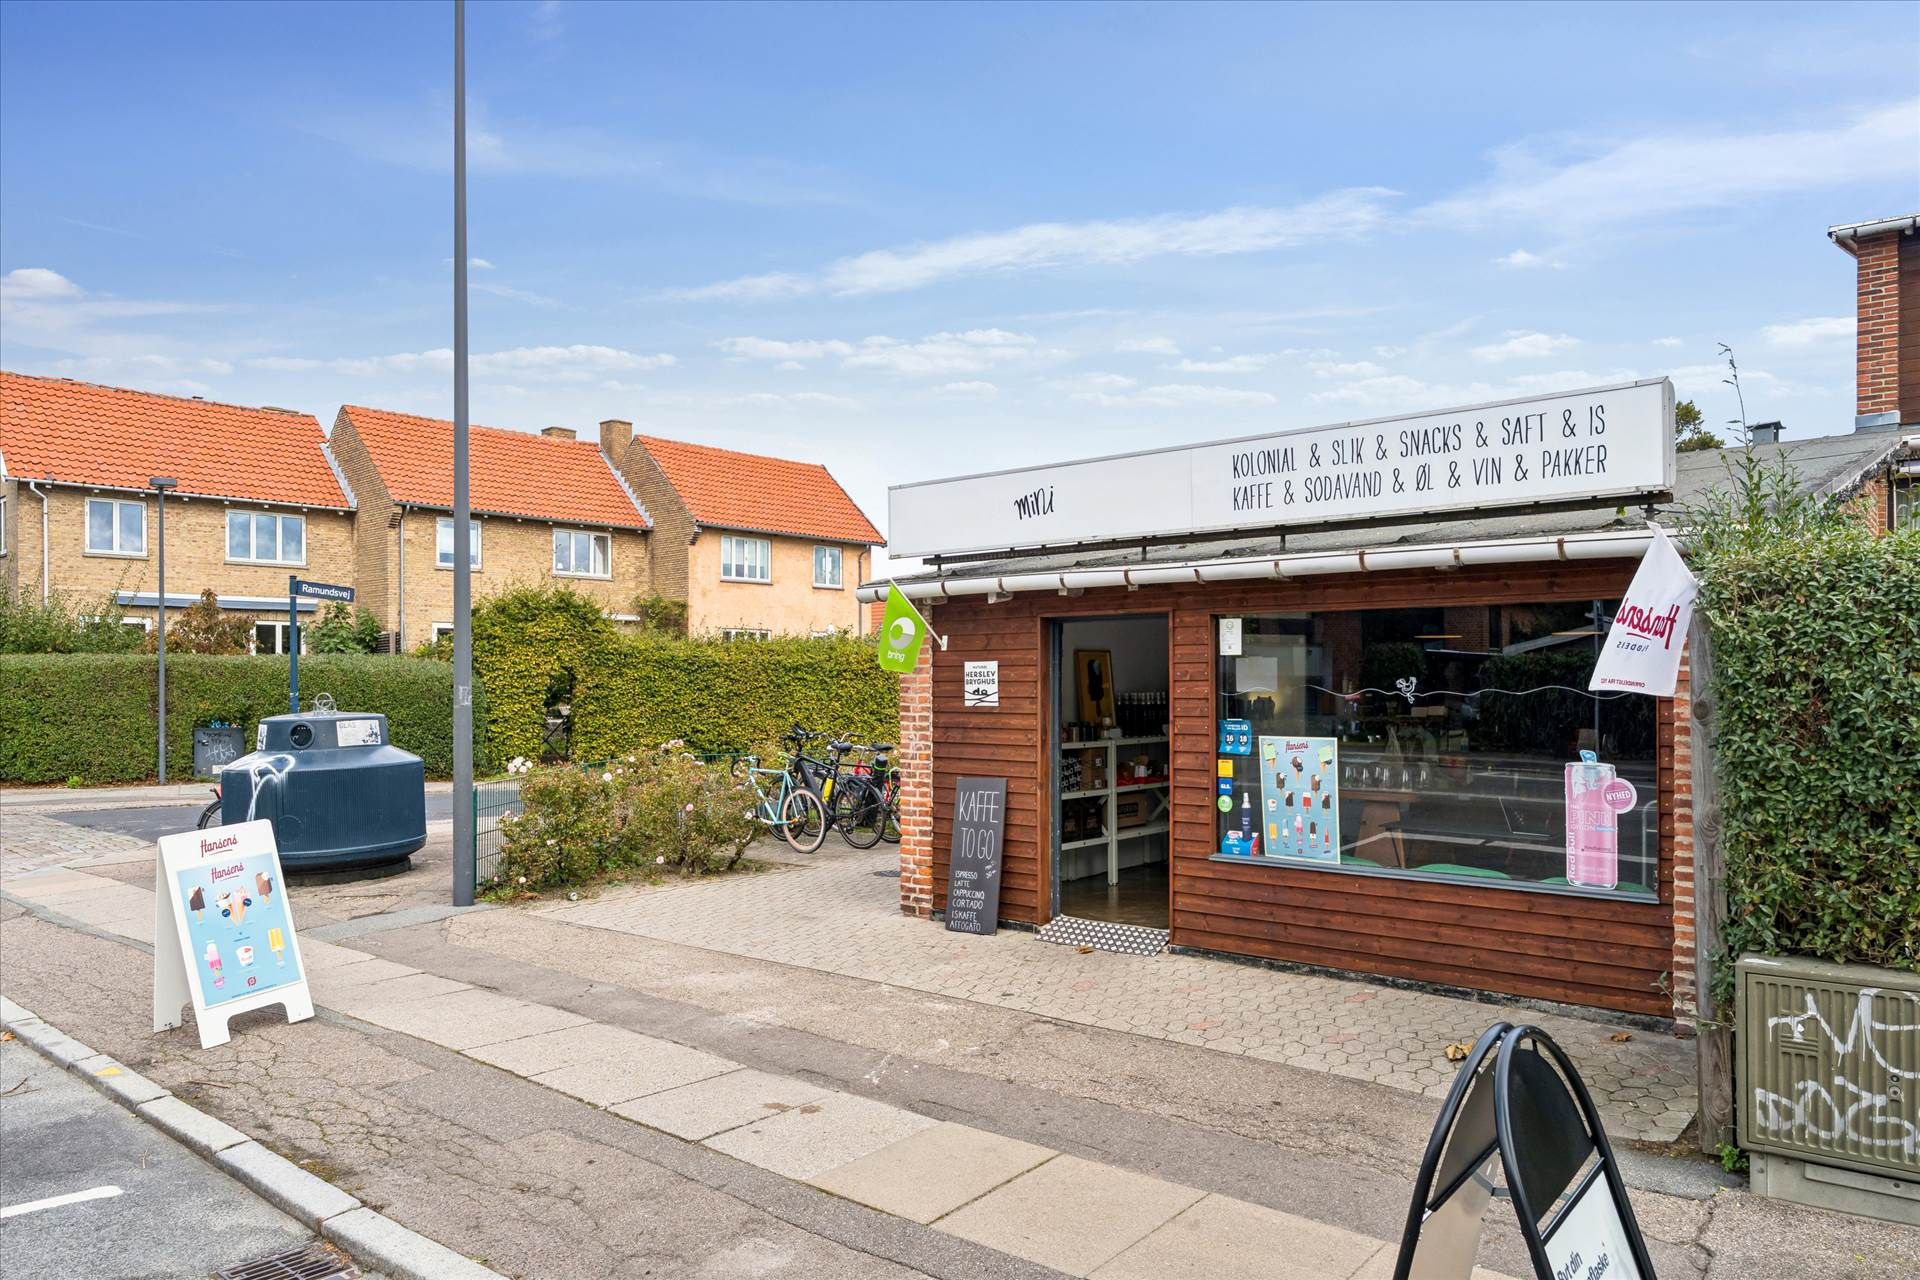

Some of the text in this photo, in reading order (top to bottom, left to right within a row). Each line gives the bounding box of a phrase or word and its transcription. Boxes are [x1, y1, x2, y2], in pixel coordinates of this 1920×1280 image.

[1233, 404, 1605, 479] KOLONIAL & SLIK & SNACKS & SAFT & IS
[1233, 444, 1608, 511] KAFFE & SODAVAND & ØL & VIN & PAKKER
[1013, 485, 1054, 520] mini
[302, 583, 351, 600] Ramundsvej
[965, 670, 996, 678] HERSLEV
[959, 790, 1000, 823] KAFFE
[1605, 789, 1632, 802] NYHED
[200, 834, 239, 858] Hansens
[960, 827, 995, 860] TO GO
[210, 862, 246, 884] Hansens
[954, 880, 970, 888] LATTE
[955, 870, 978, 880] ESPRESSO
[952, 898, 984, 910] CORTADO
[1569, 1251, 1583, 1275] din
[1586, 1252, 1611, 1280] flaske
